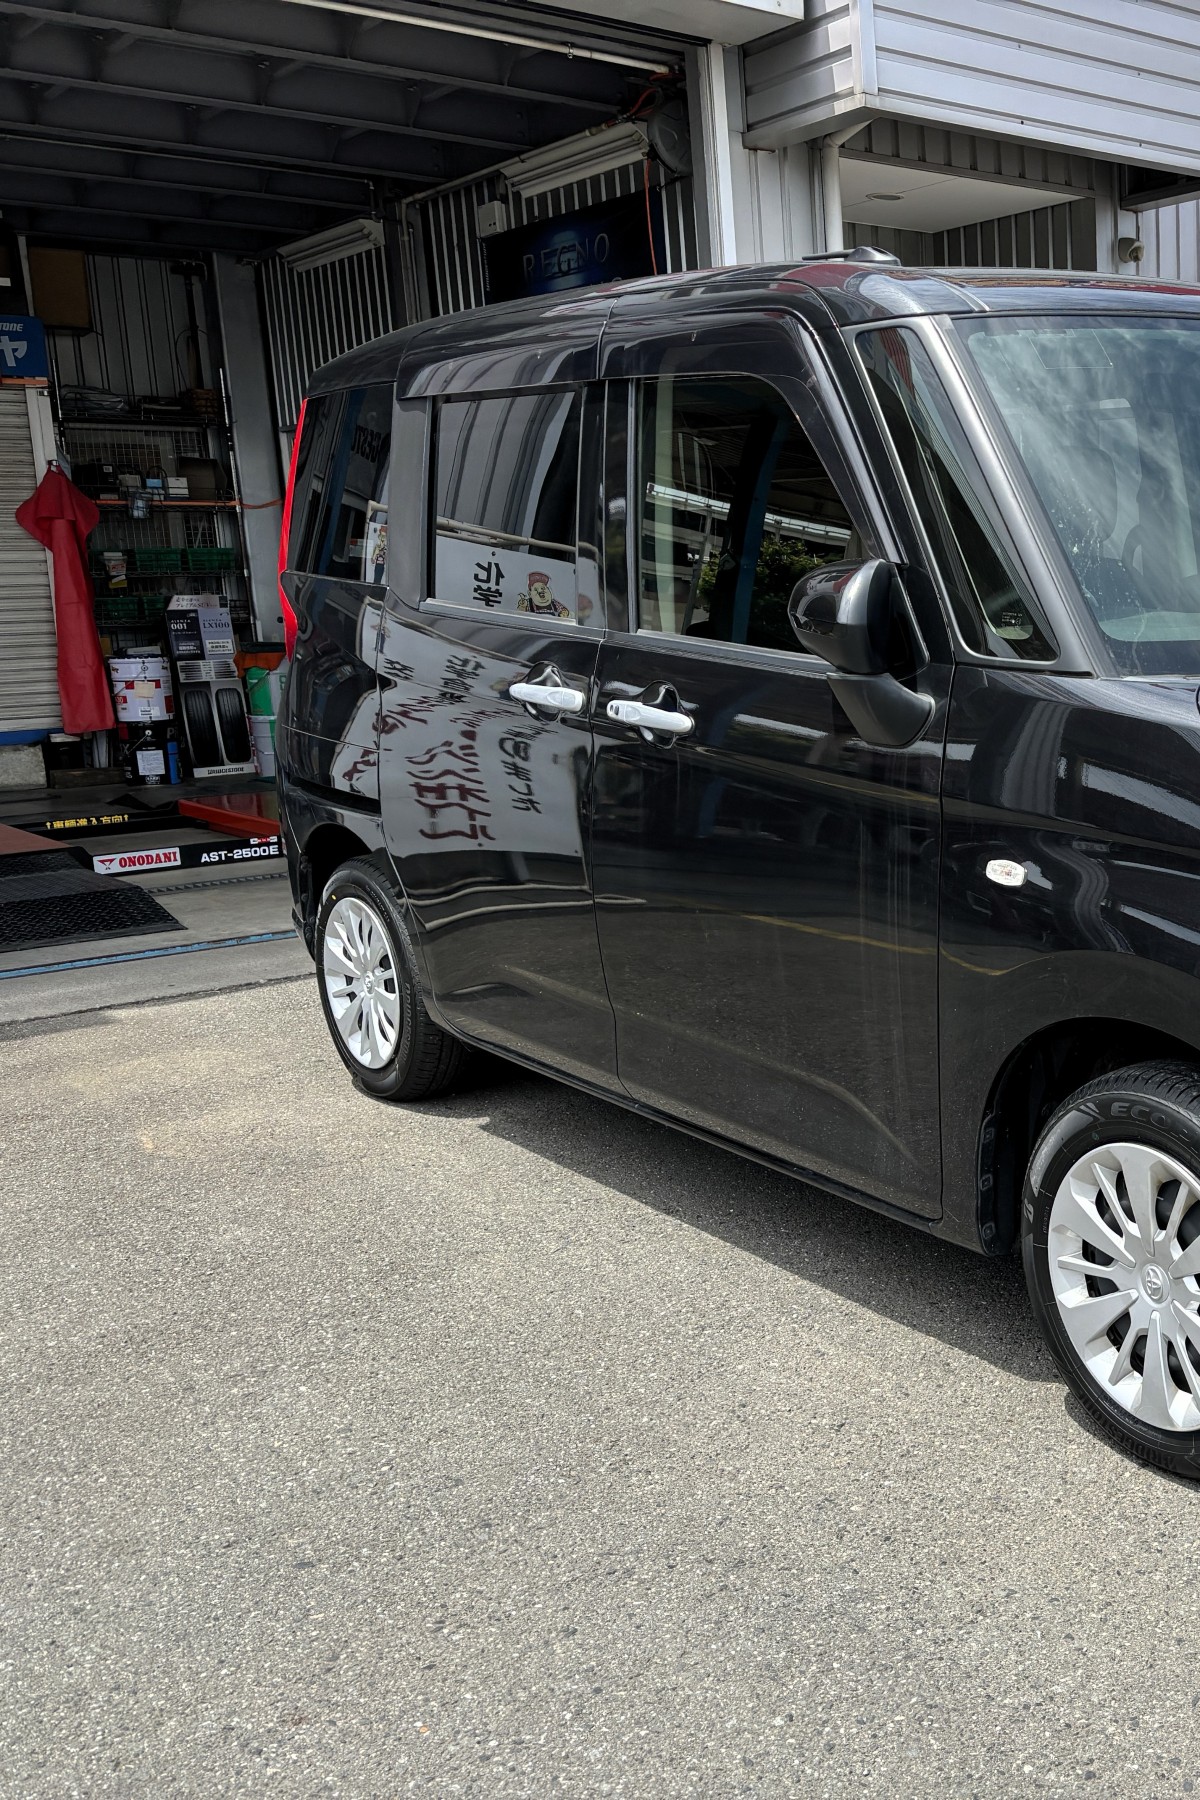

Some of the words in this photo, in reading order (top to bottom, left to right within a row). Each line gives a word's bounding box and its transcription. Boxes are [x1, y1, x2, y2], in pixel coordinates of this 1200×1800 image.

[522, 233, 610, 282] REGNO
[119, 851, 178, 868] ONODANI
[201, 845, 280, 863] AST-2500E
